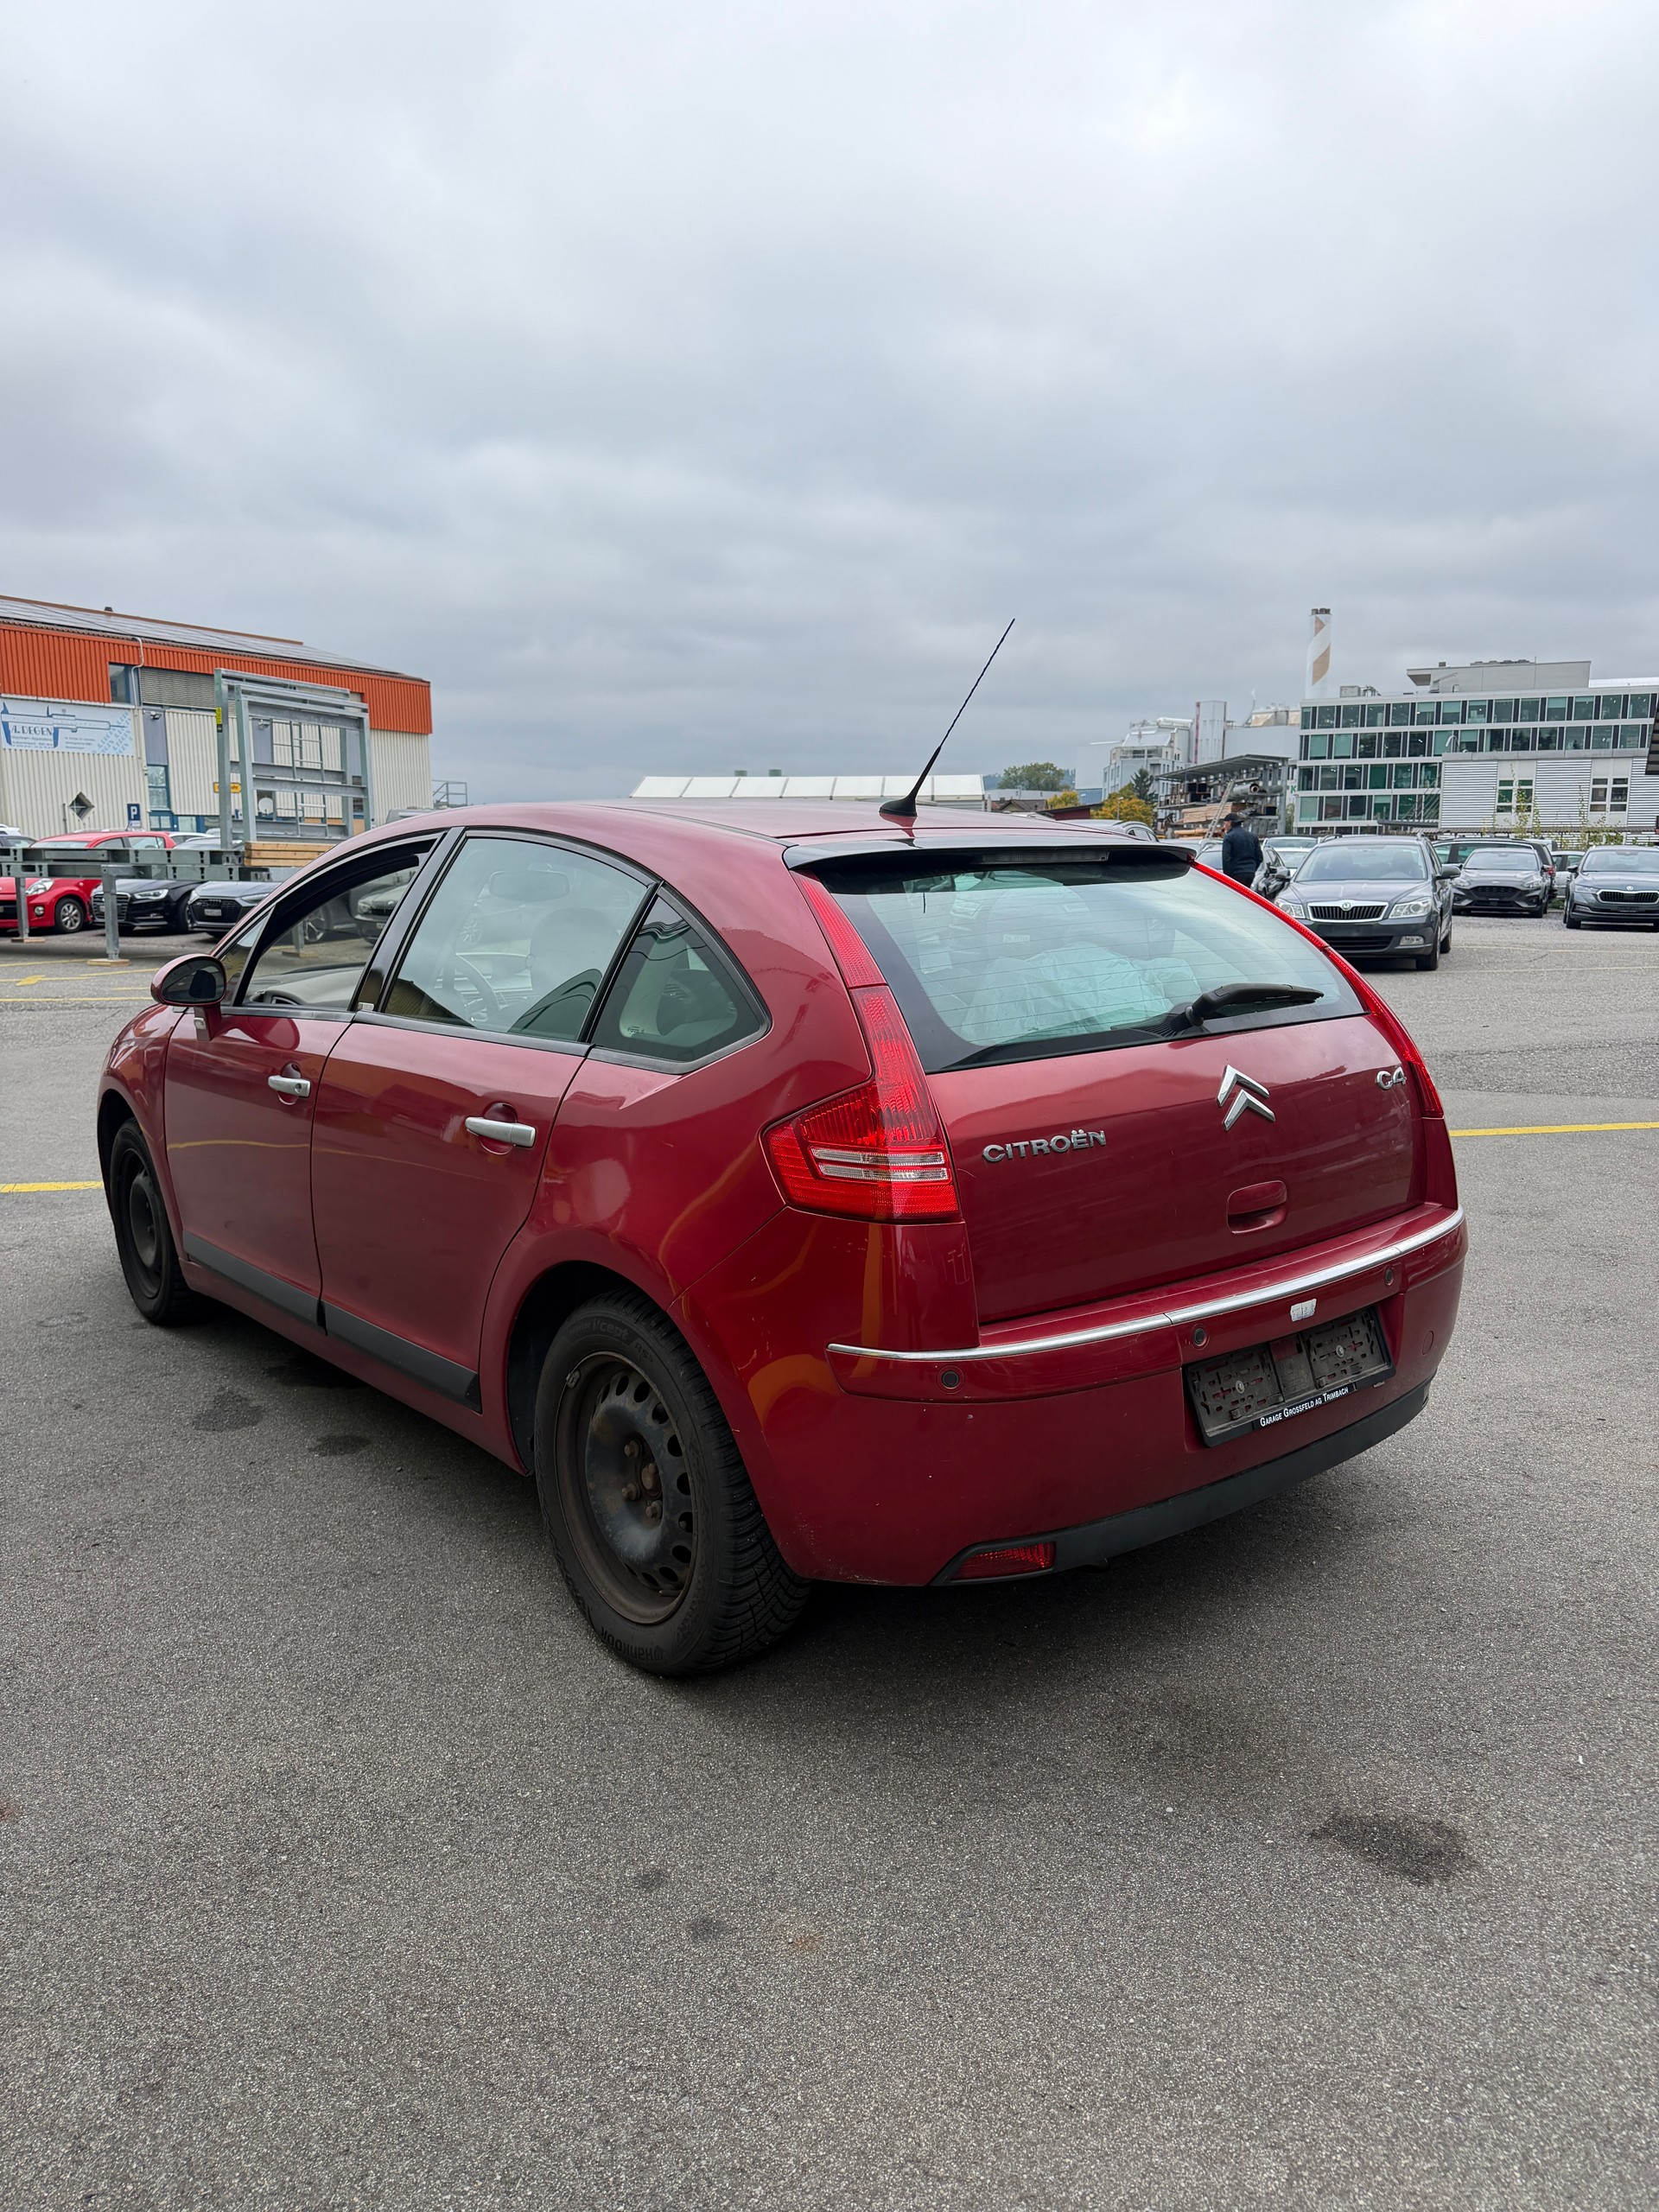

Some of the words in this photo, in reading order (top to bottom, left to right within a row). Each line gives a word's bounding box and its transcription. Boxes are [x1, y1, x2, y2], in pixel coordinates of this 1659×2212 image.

[22, 726, 52, 735] DEGEN
[130, 806, 137, 819] P
[1376, 1066, 1407, 1090] C4
[982, 1129, 1107, 1163] CITROËN
[1260, 1413, 1282, 1427] GARAGE
[1283, 1401, 1314, 1418] GROSSFELD
[1315, 1397, 1323, 1406] AG
[1323, 1387, 1349, 1402] TRIMBACH
